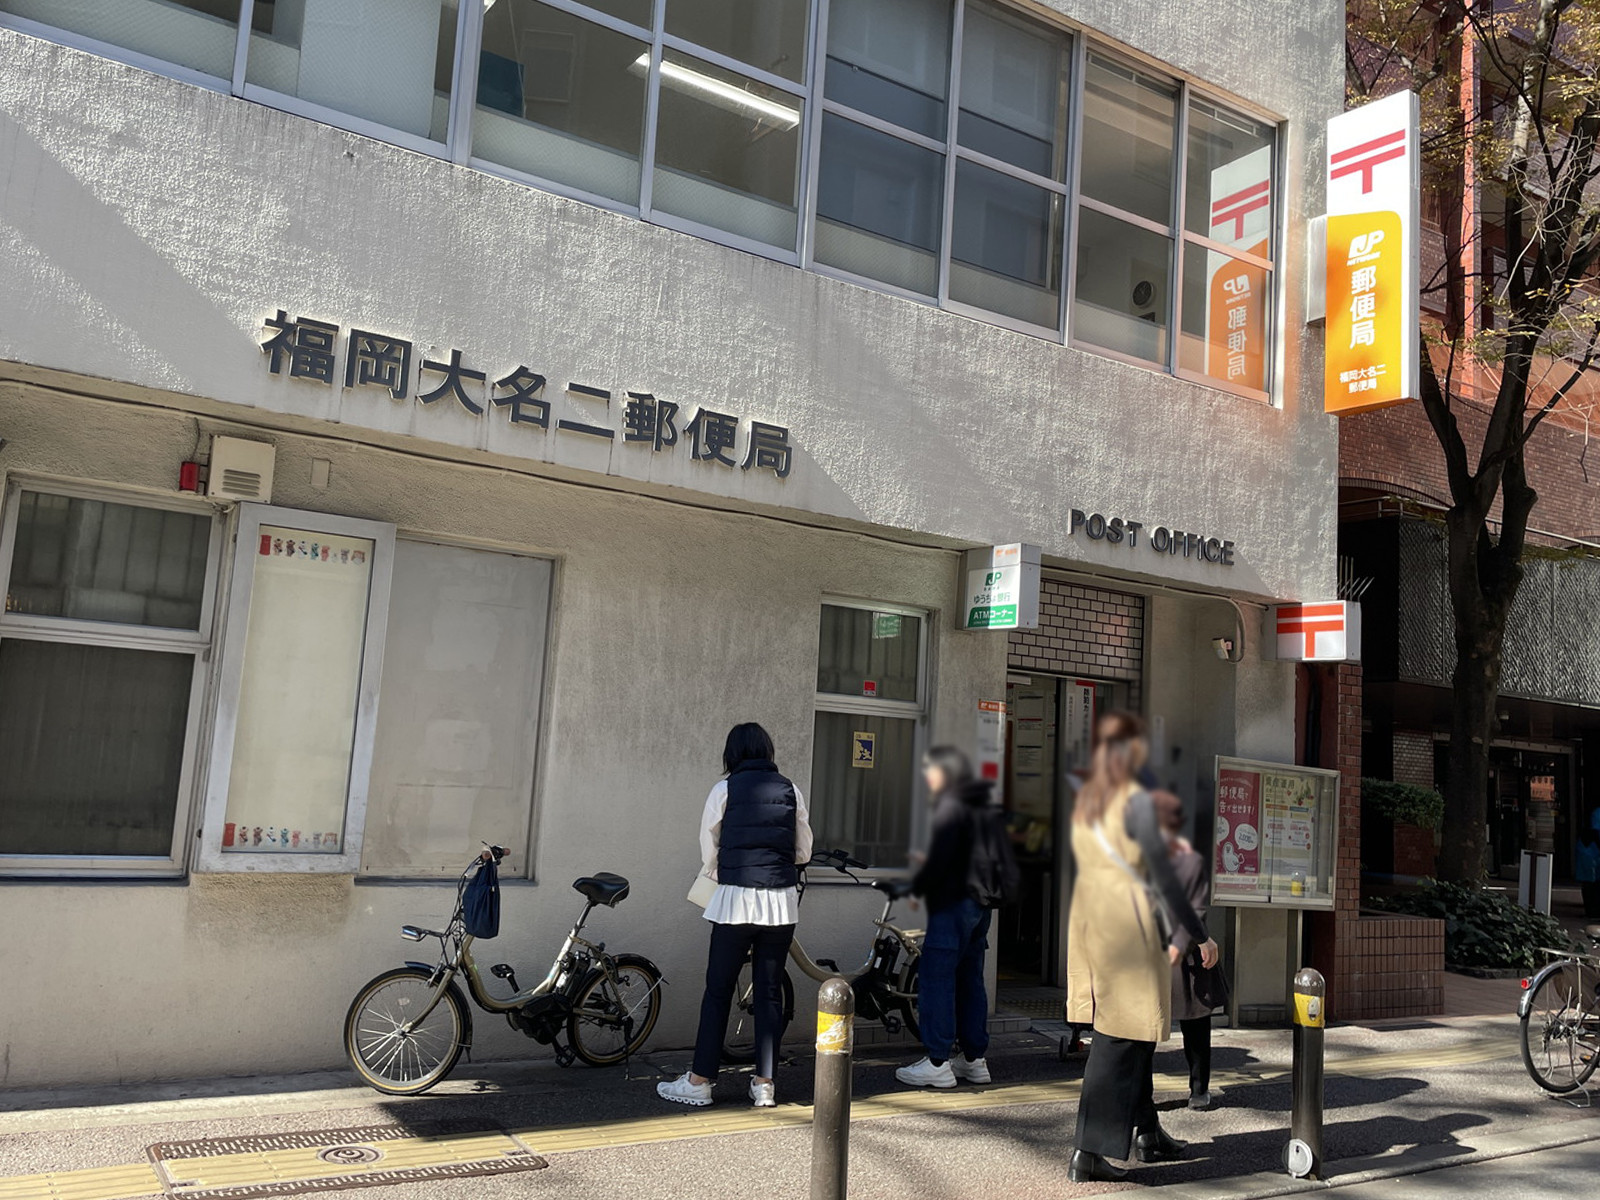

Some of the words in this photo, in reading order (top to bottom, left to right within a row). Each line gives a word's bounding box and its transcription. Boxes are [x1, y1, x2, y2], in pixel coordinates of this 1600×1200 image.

[1349, 265, 1377, 349] 郵便局
[1339, 364, 1387, 384] 福岡大名二
[259, 308, 793, 478] 福岡大名二郵便局
[1348, 377, 1378, 394] 郵便局
[1068, 508, 1143, 548] POST
[1150, 525, 1235, 566] OFFICE
[973, 592, 1011, 605] ゆうちょ銀行
[973, 608, 1014, 620] ATMコーナー
